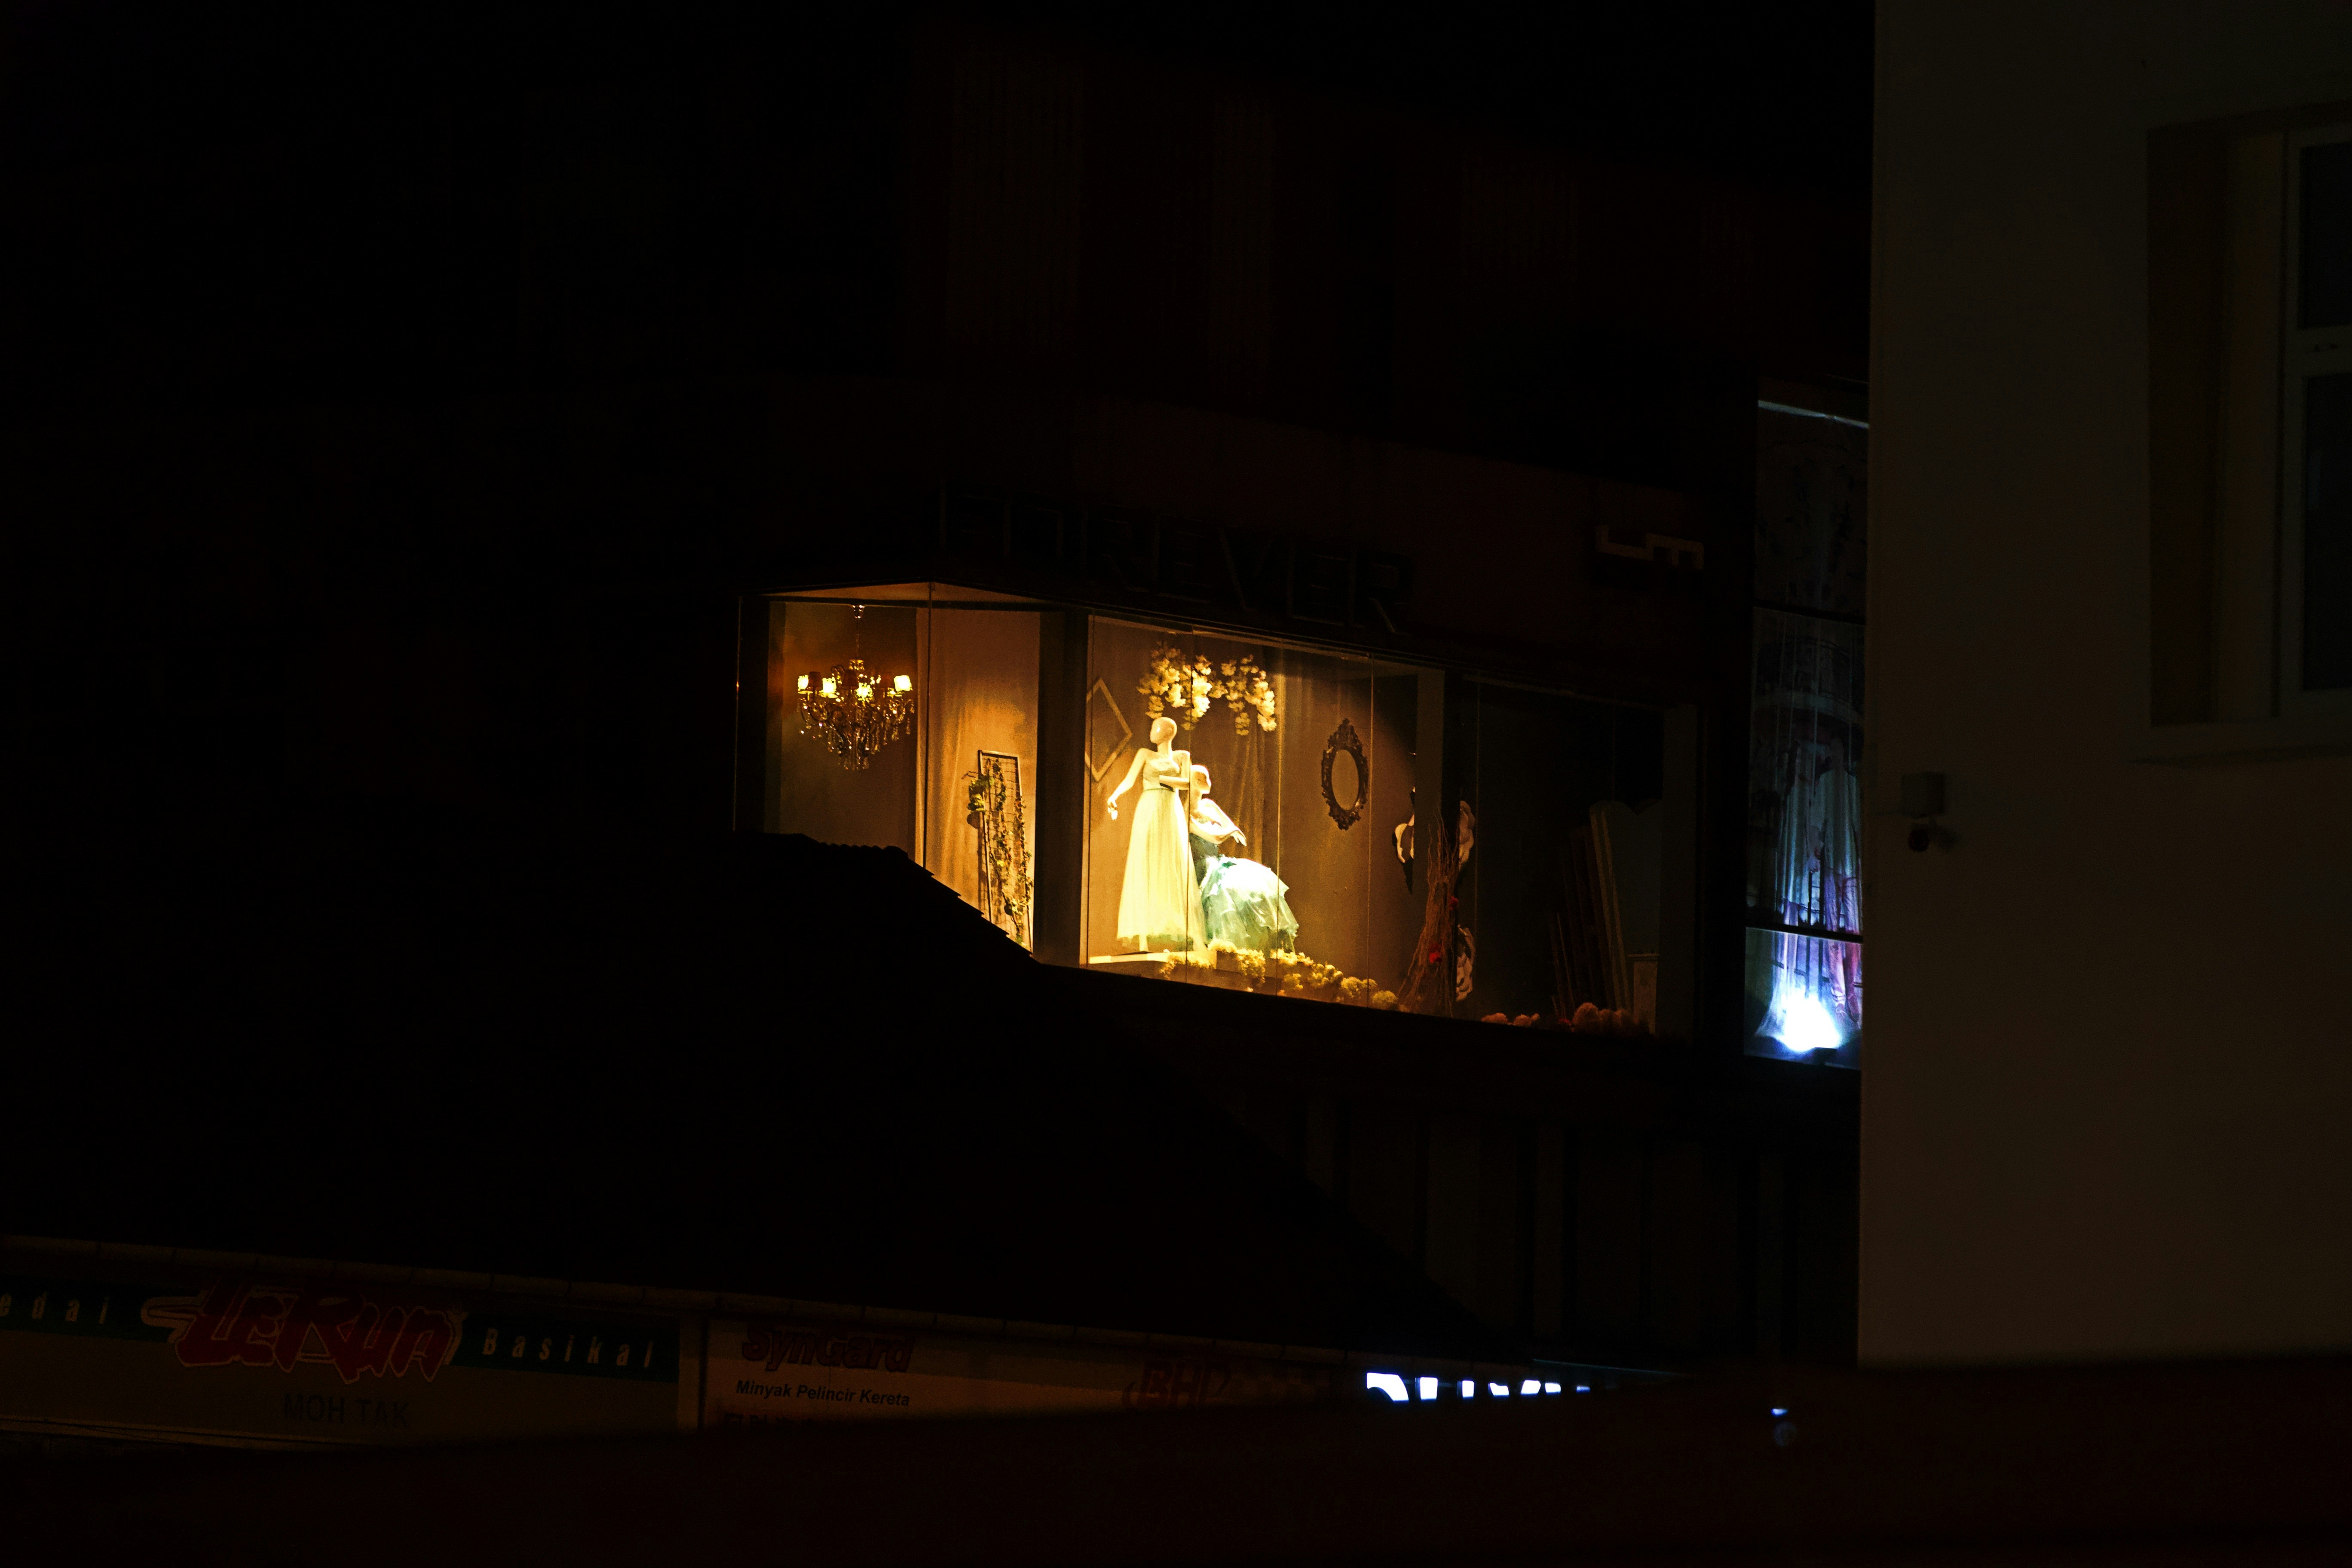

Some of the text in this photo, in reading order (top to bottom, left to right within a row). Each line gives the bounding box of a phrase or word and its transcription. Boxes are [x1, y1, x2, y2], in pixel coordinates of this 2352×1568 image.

[937, 475, 1416, 637] FOREVER
[482, 1327, 654, 1369] Basikal
[742, 1320, 916, 1372] SynGard
[283, 1393, 410, 1429] MOH TAK
[735, 1379, 910, 1407] Minyak Pelincir Kereta
